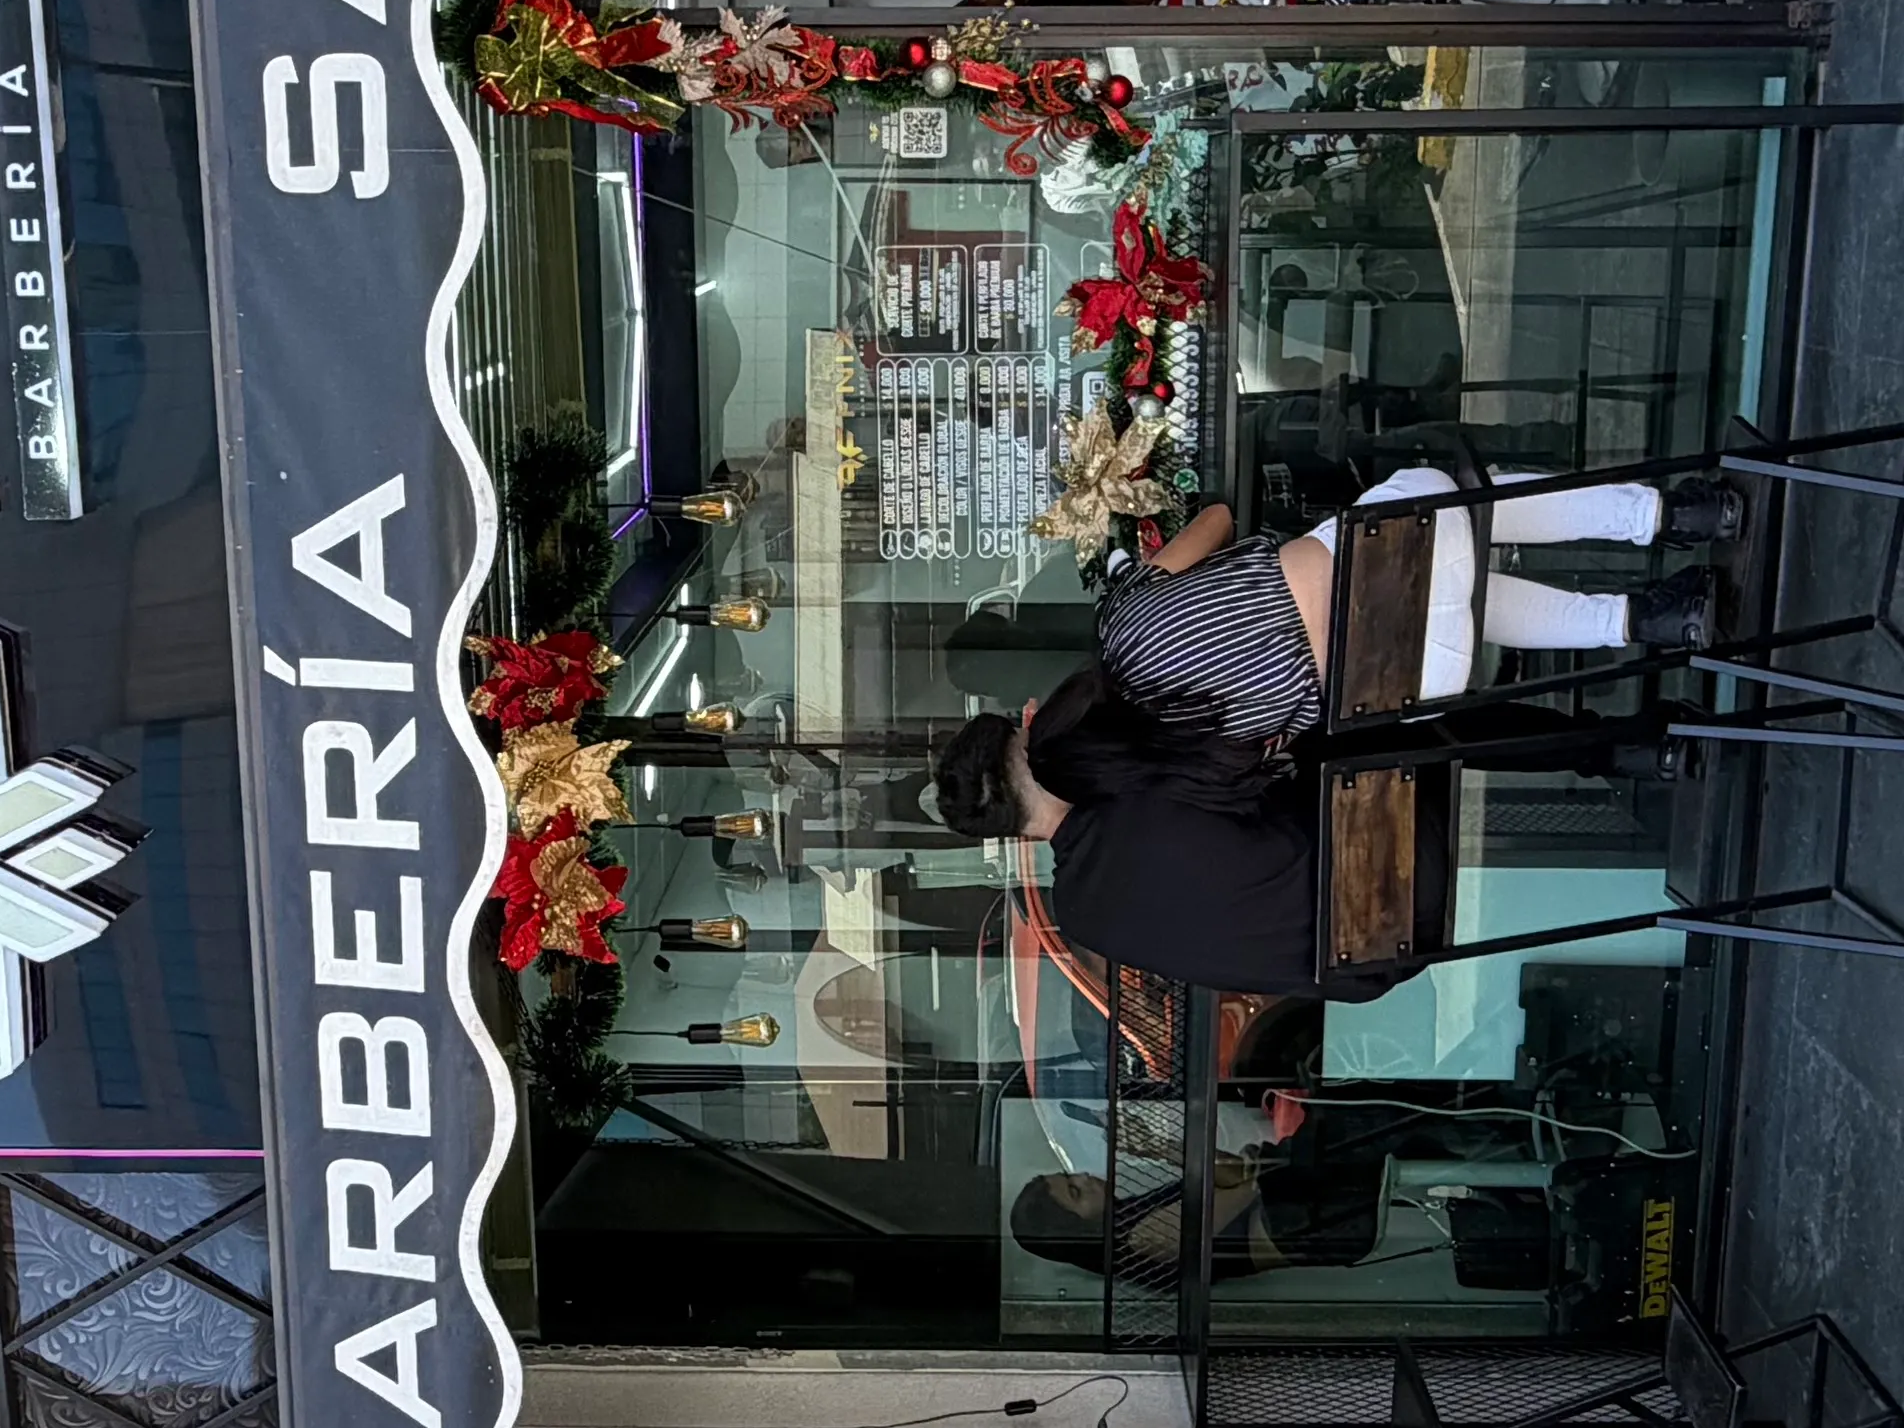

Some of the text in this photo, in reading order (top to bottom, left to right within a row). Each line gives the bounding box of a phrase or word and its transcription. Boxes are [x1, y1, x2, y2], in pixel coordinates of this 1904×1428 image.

[882, 438, 894, 479] CABELLO
[919, 432, 931, 473] CABELLO
[998, 443, 1010, 454] DE
[919, 475, 931, 486] DE
[980, 460, 992, 472] DE
[883, 481, 895, 493] DE
[980, 474, 992, 522] PERFILADO
[1016, 474, 1028, 522] PERFILADO
[883, 495, 895, 524] CORTE
